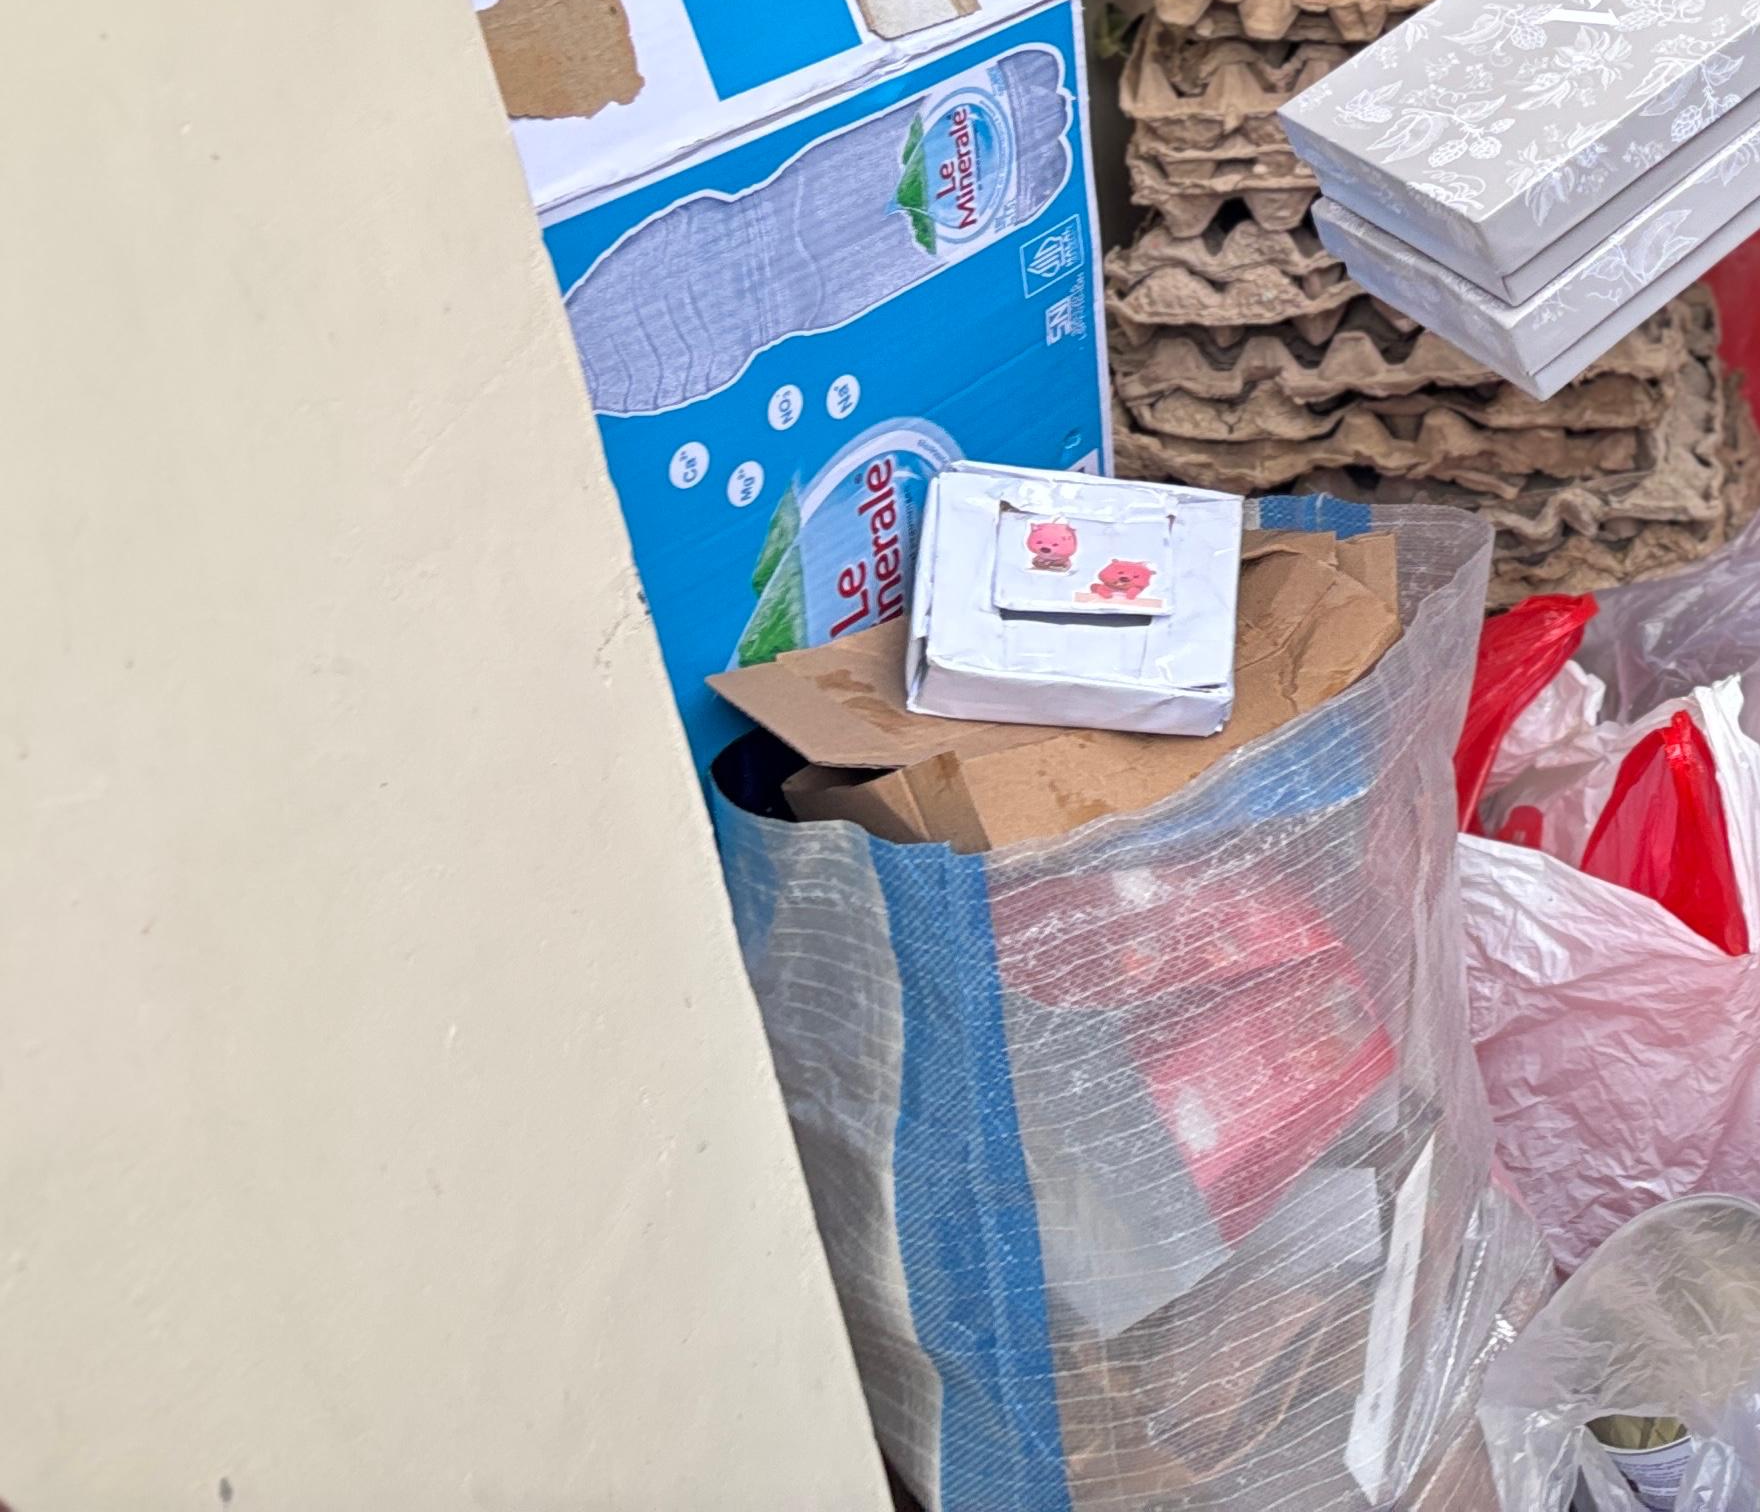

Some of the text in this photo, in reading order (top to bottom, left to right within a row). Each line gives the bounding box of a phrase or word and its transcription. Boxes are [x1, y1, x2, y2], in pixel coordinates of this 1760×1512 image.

[936, 161, 955, 200] Le
[950, 107, 977, 230] Minerale
[858, 457, 904, 628] inerale
[829, 561, 870, 638] Le
